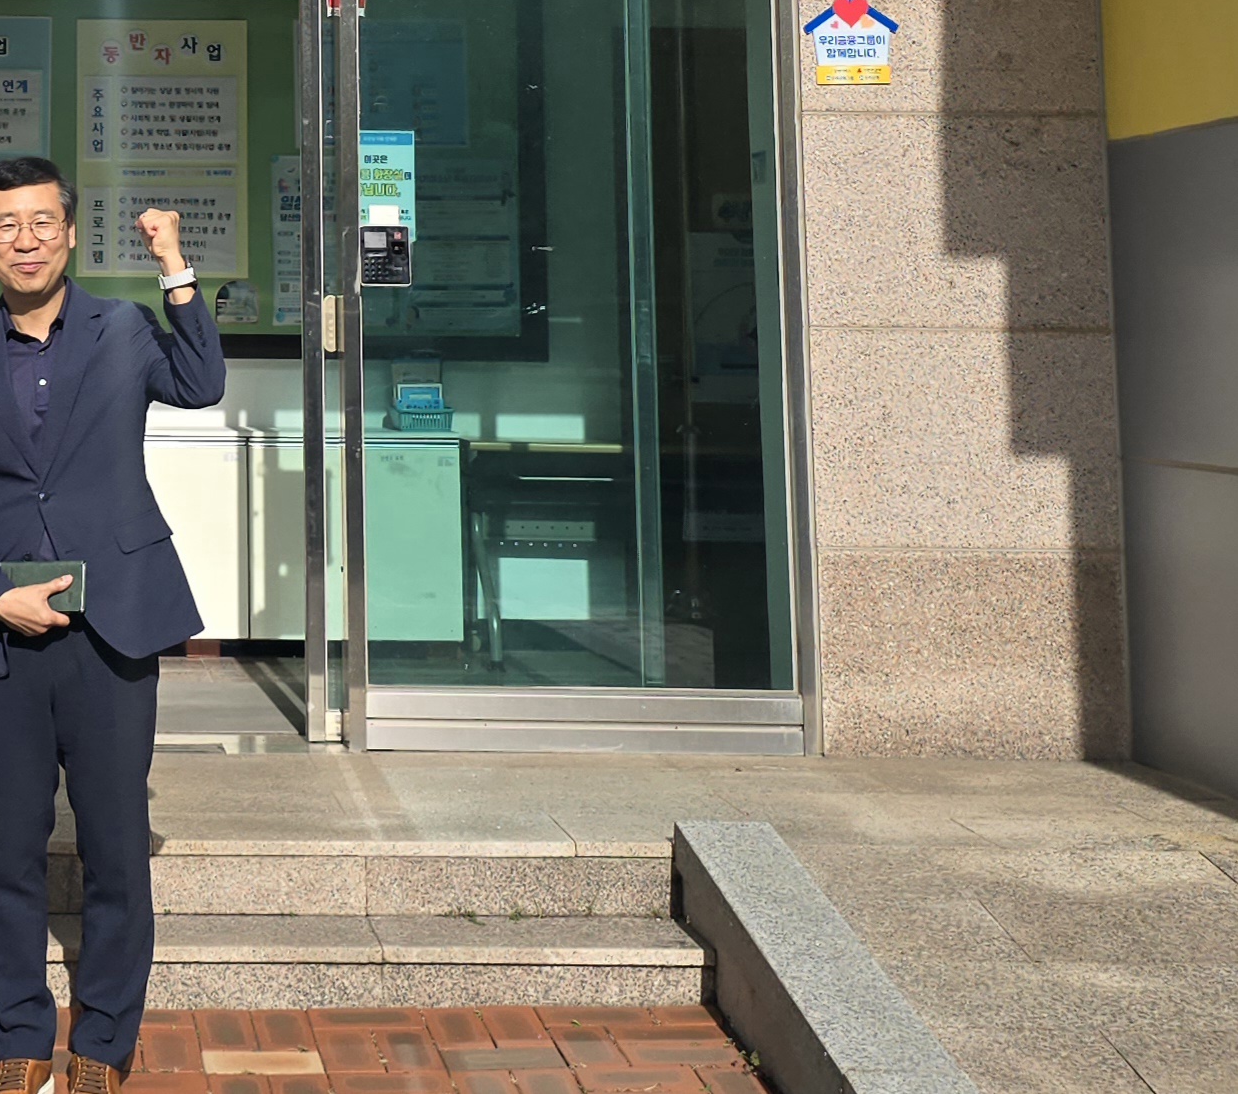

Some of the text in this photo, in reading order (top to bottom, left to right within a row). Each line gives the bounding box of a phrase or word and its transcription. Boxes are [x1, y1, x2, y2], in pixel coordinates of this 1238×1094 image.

[818, 35, 886, 46] 우리금융그룹이
[826, 48, 880, 58] 함께합니다.
[2, 79, 29, 93] 연계
[92, 89, 104, 153] 주요사업
[364, 155, 388, 164] 이곳은
[92, 200, 105, 263] 프로그램
